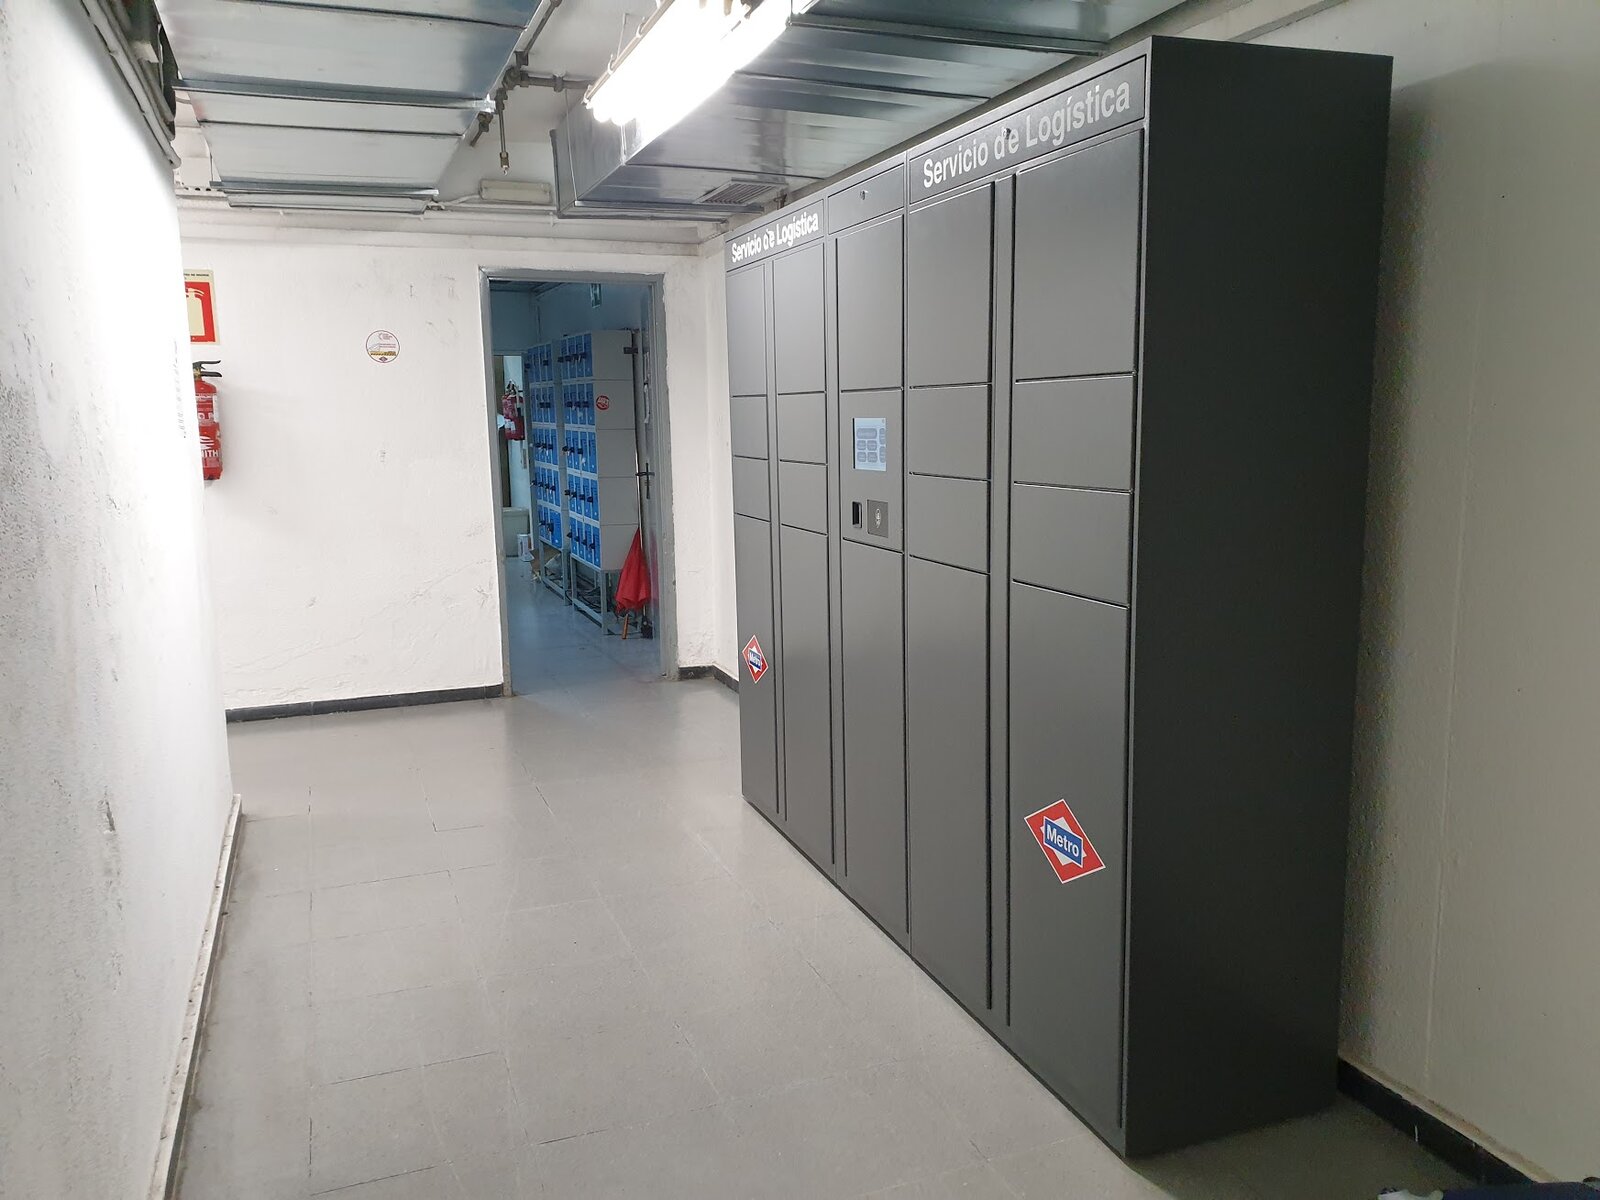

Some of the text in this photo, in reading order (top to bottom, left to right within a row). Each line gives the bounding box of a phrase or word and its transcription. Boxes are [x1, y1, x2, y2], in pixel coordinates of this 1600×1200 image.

[923, 81, 1131, 188] Servicio de Logística
[731, 211, 819, 263] Servicio de Logística
[1046, 824, 1080, 858] Metro
